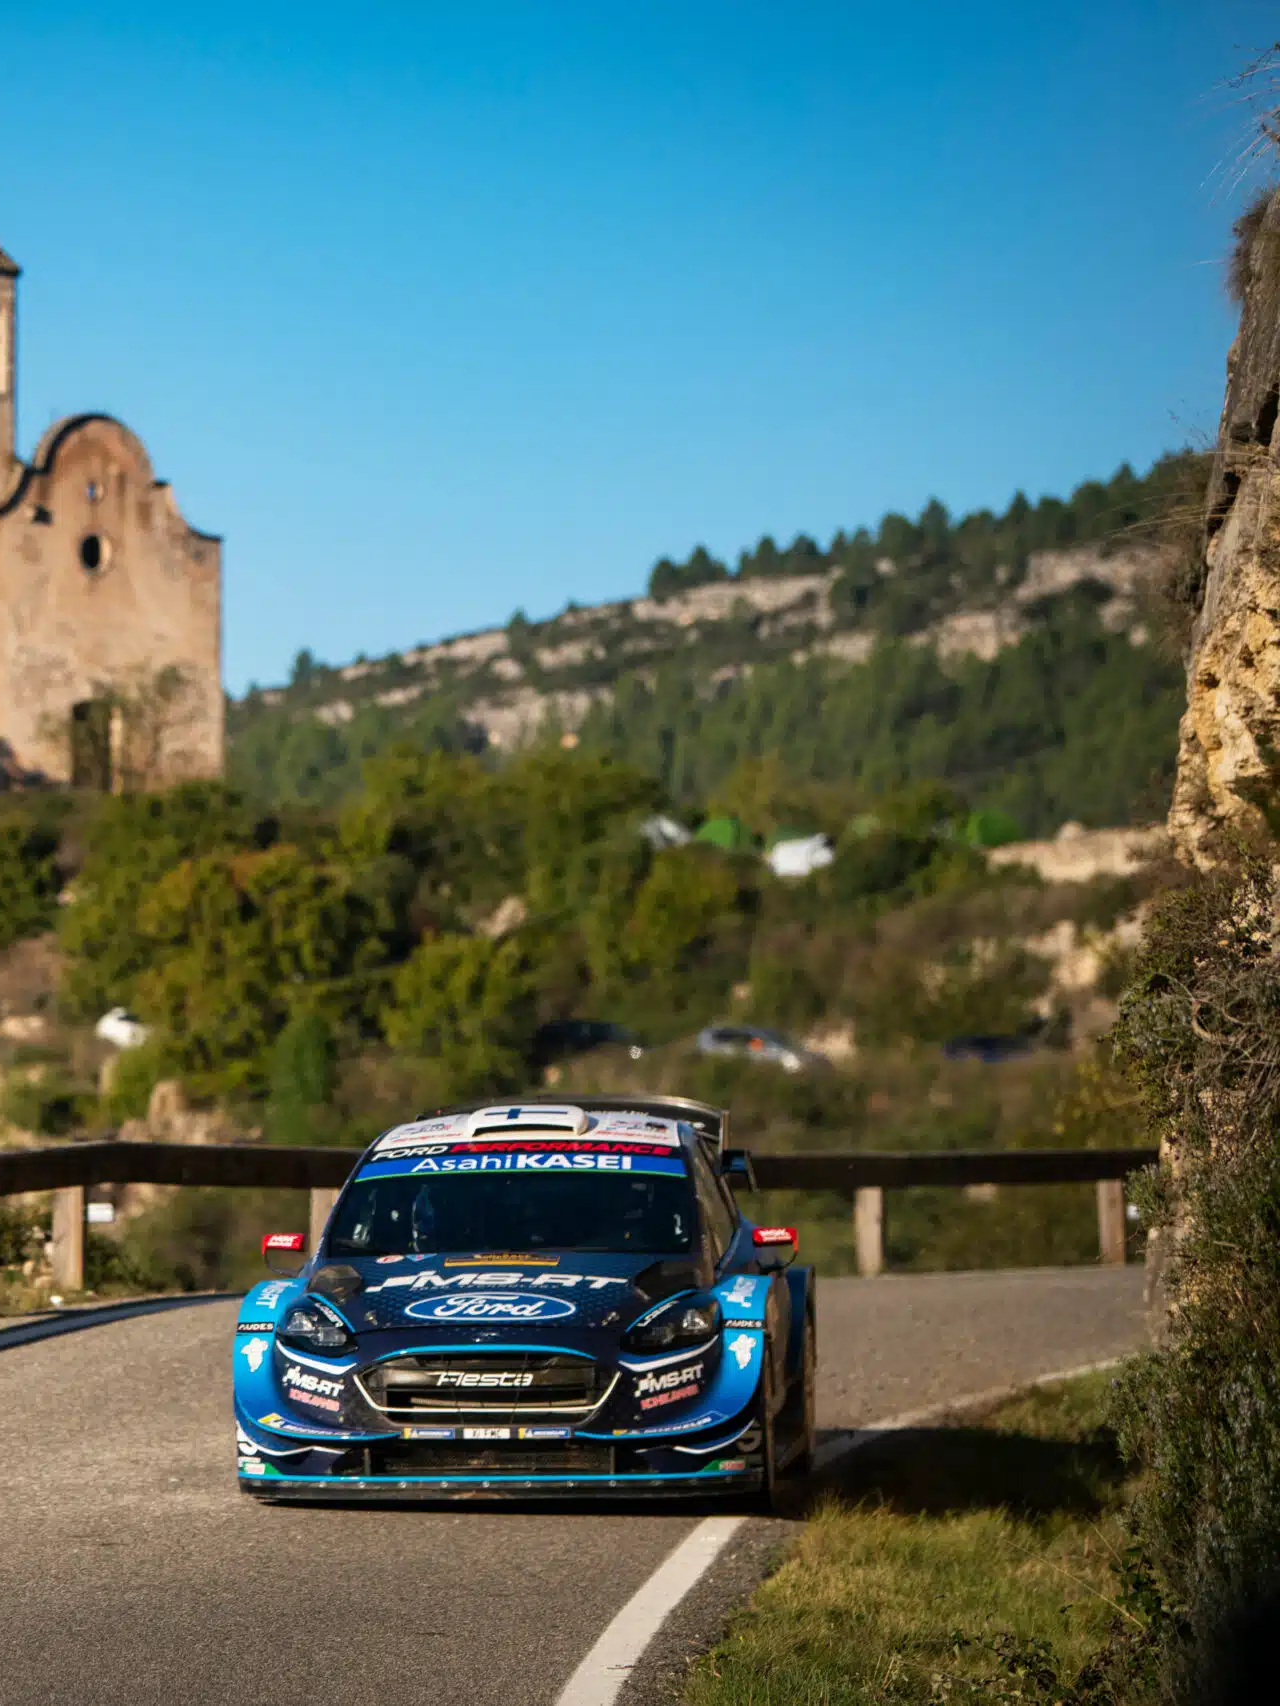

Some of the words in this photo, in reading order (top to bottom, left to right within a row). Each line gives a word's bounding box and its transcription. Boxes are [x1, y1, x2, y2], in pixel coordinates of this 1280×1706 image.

[371, 1145, 449, 1161] FORD
[449, 1141, 673, 1156] PERFORMANCE
[433, 1294, 546, 1317] Ford
[427, 1371, 534, 1387] Fiesta
